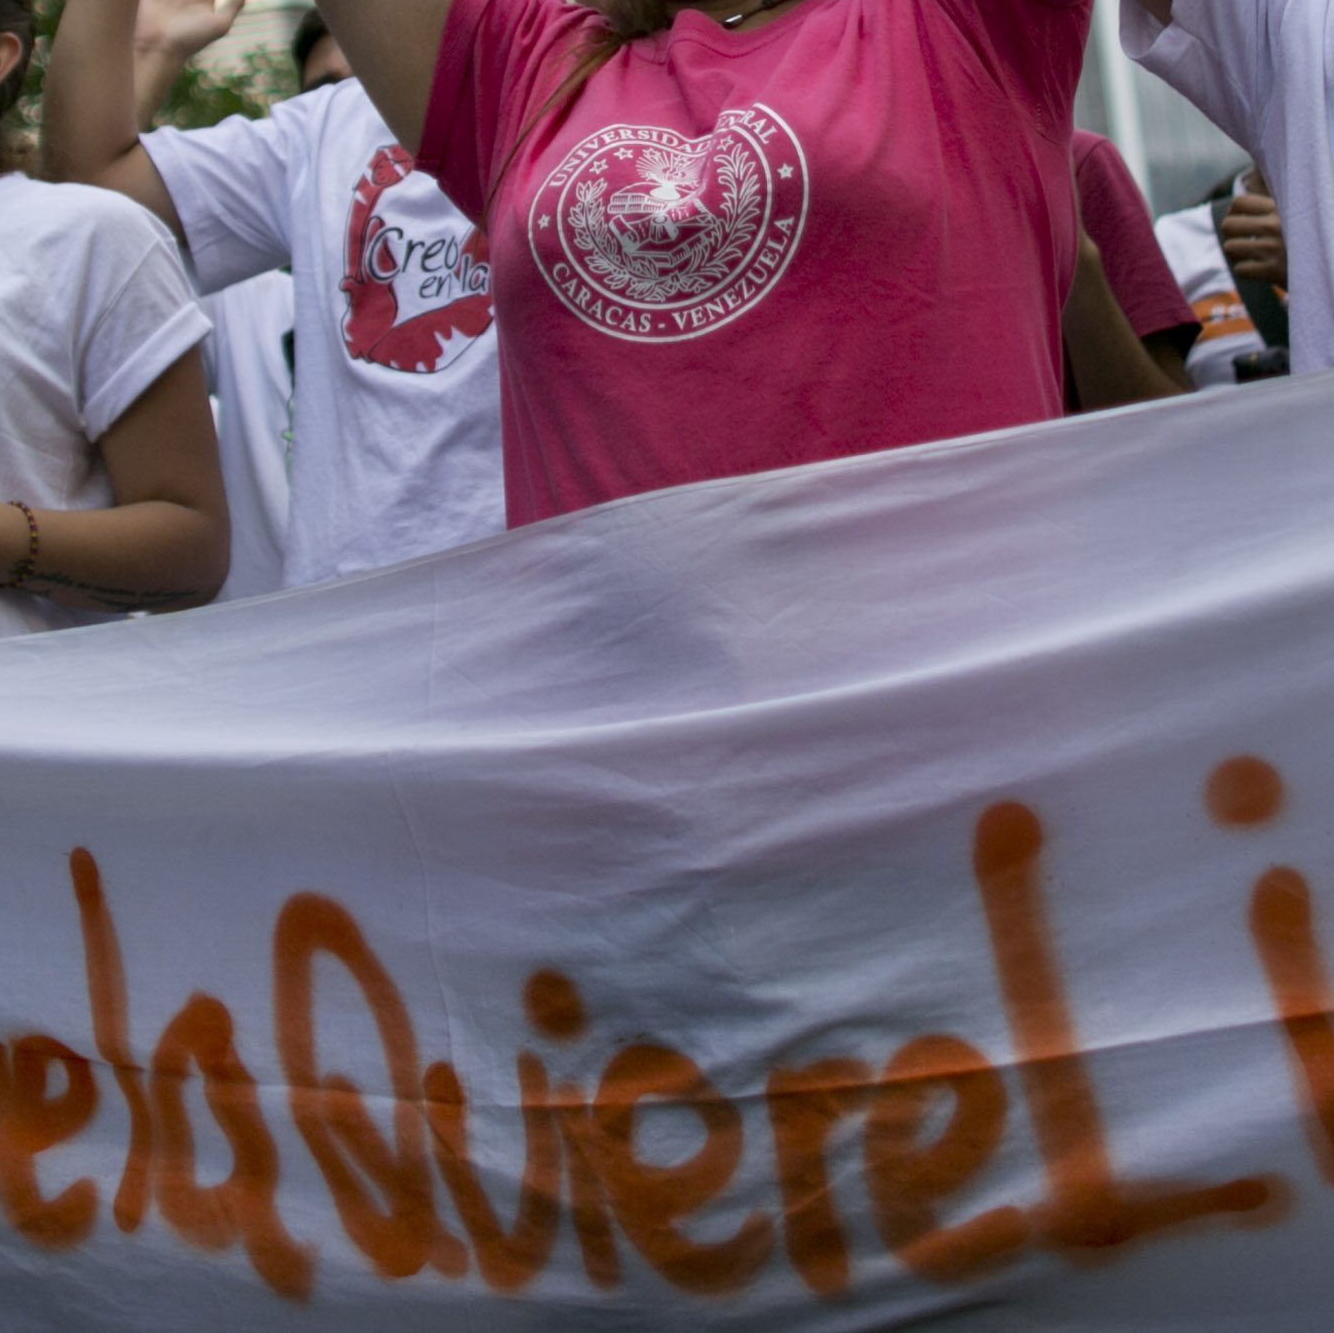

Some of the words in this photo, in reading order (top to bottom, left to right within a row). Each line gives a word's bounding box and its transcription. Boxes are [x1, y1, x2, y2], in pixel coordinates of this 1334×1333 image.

[549, 128, 713, 188] UNIVERSIDAD
[368, 226, 459, 282] Creo
[418, 272, 453, 300] en
[461, 255, 489, 293] la
[552, 262, 652, 333] CARACAS
[671, 216, 795, 331] VENEZUELA
